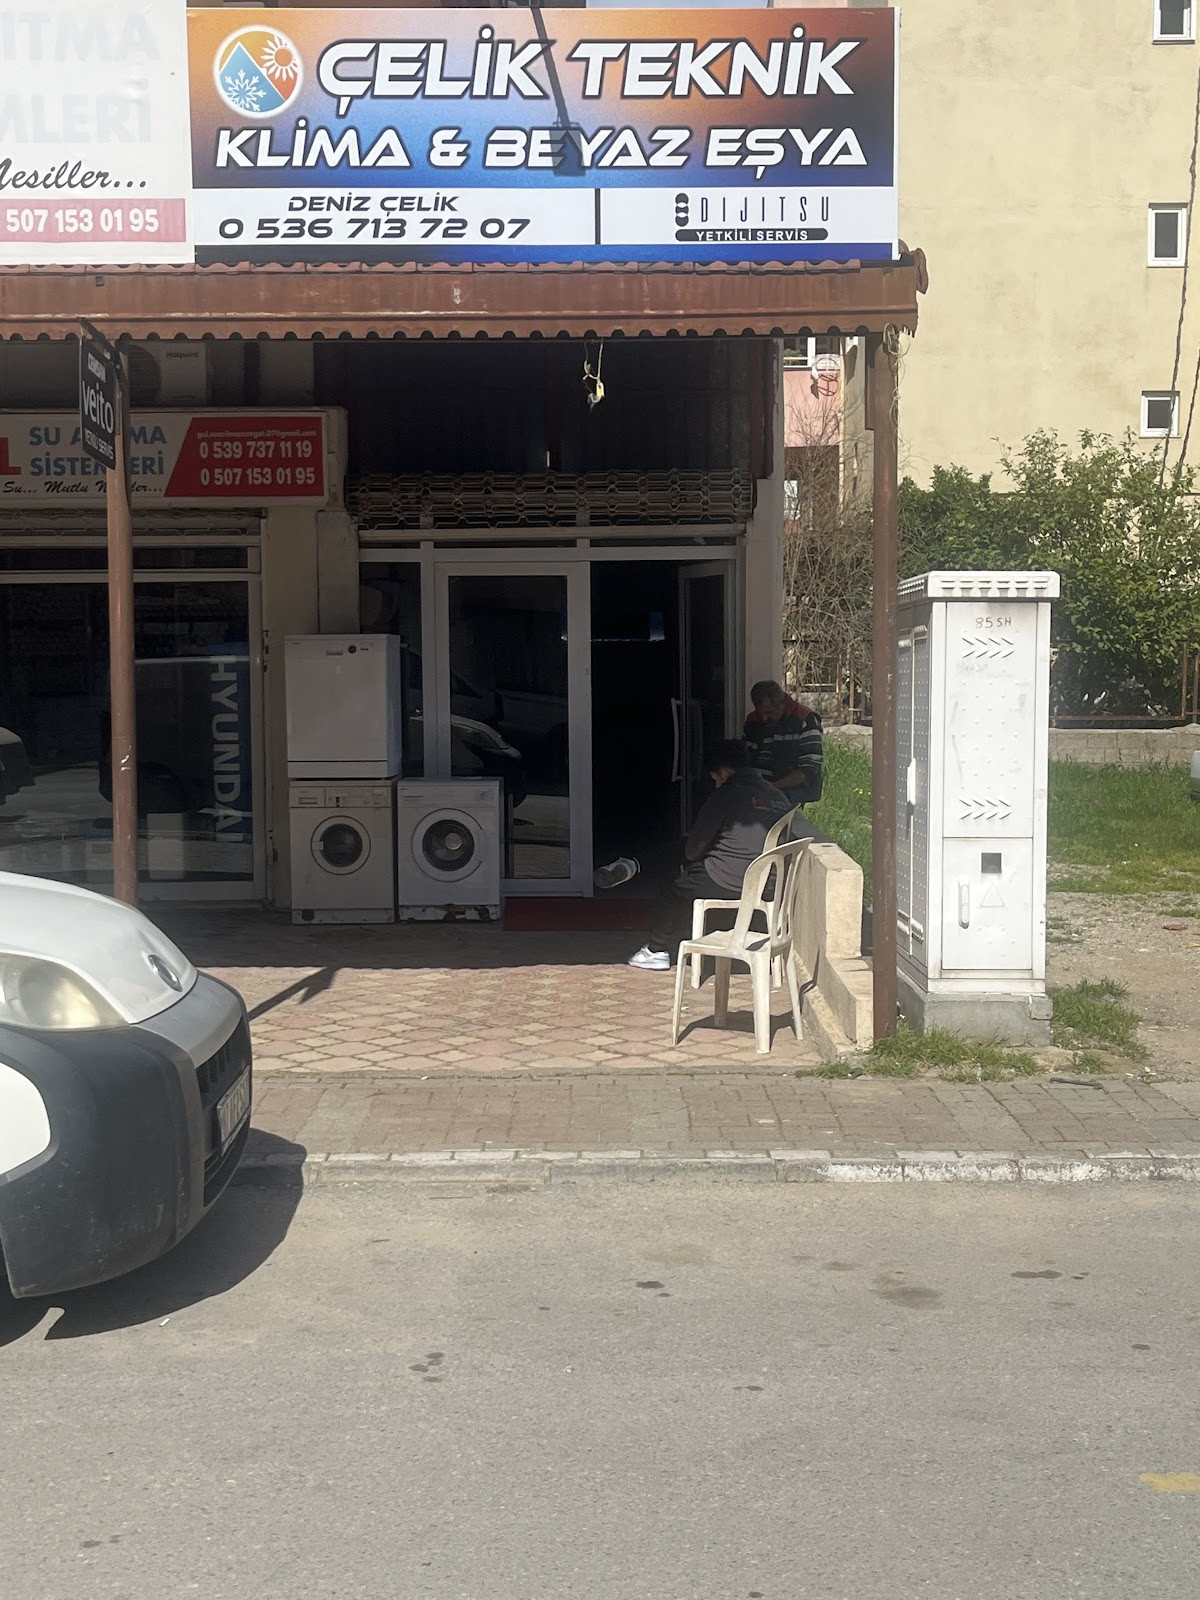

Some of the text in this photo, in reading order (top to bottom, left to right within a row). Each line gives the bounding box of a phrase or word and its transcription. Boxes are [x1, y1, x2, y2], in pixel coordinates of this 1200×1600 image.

[318, 24, 863, 118] ÇELİK TEKNİK
[213, 117, 870, 181] KLİMA & BEYAZ EŞYA
[288, 192, 459, 217] DENİZ ÇELİK
[701, 196, 829, 223] DIJITSU
[6, 208, 160, 233] 507 153 01 95
[218, 218, 531, 239] 0 536 713 72 07
[696, 228, 808, 242] YETKİLİ SERVİS
[29, 426, 61, 446] SU
[200, 439, 312, 459] 0 539 737 11 19
[44, 481, 89, 493] Mutlu
[201, 467, 315, 486] 0 507 153 01 95
[210, 655, 243, 842] HYUNDAI
